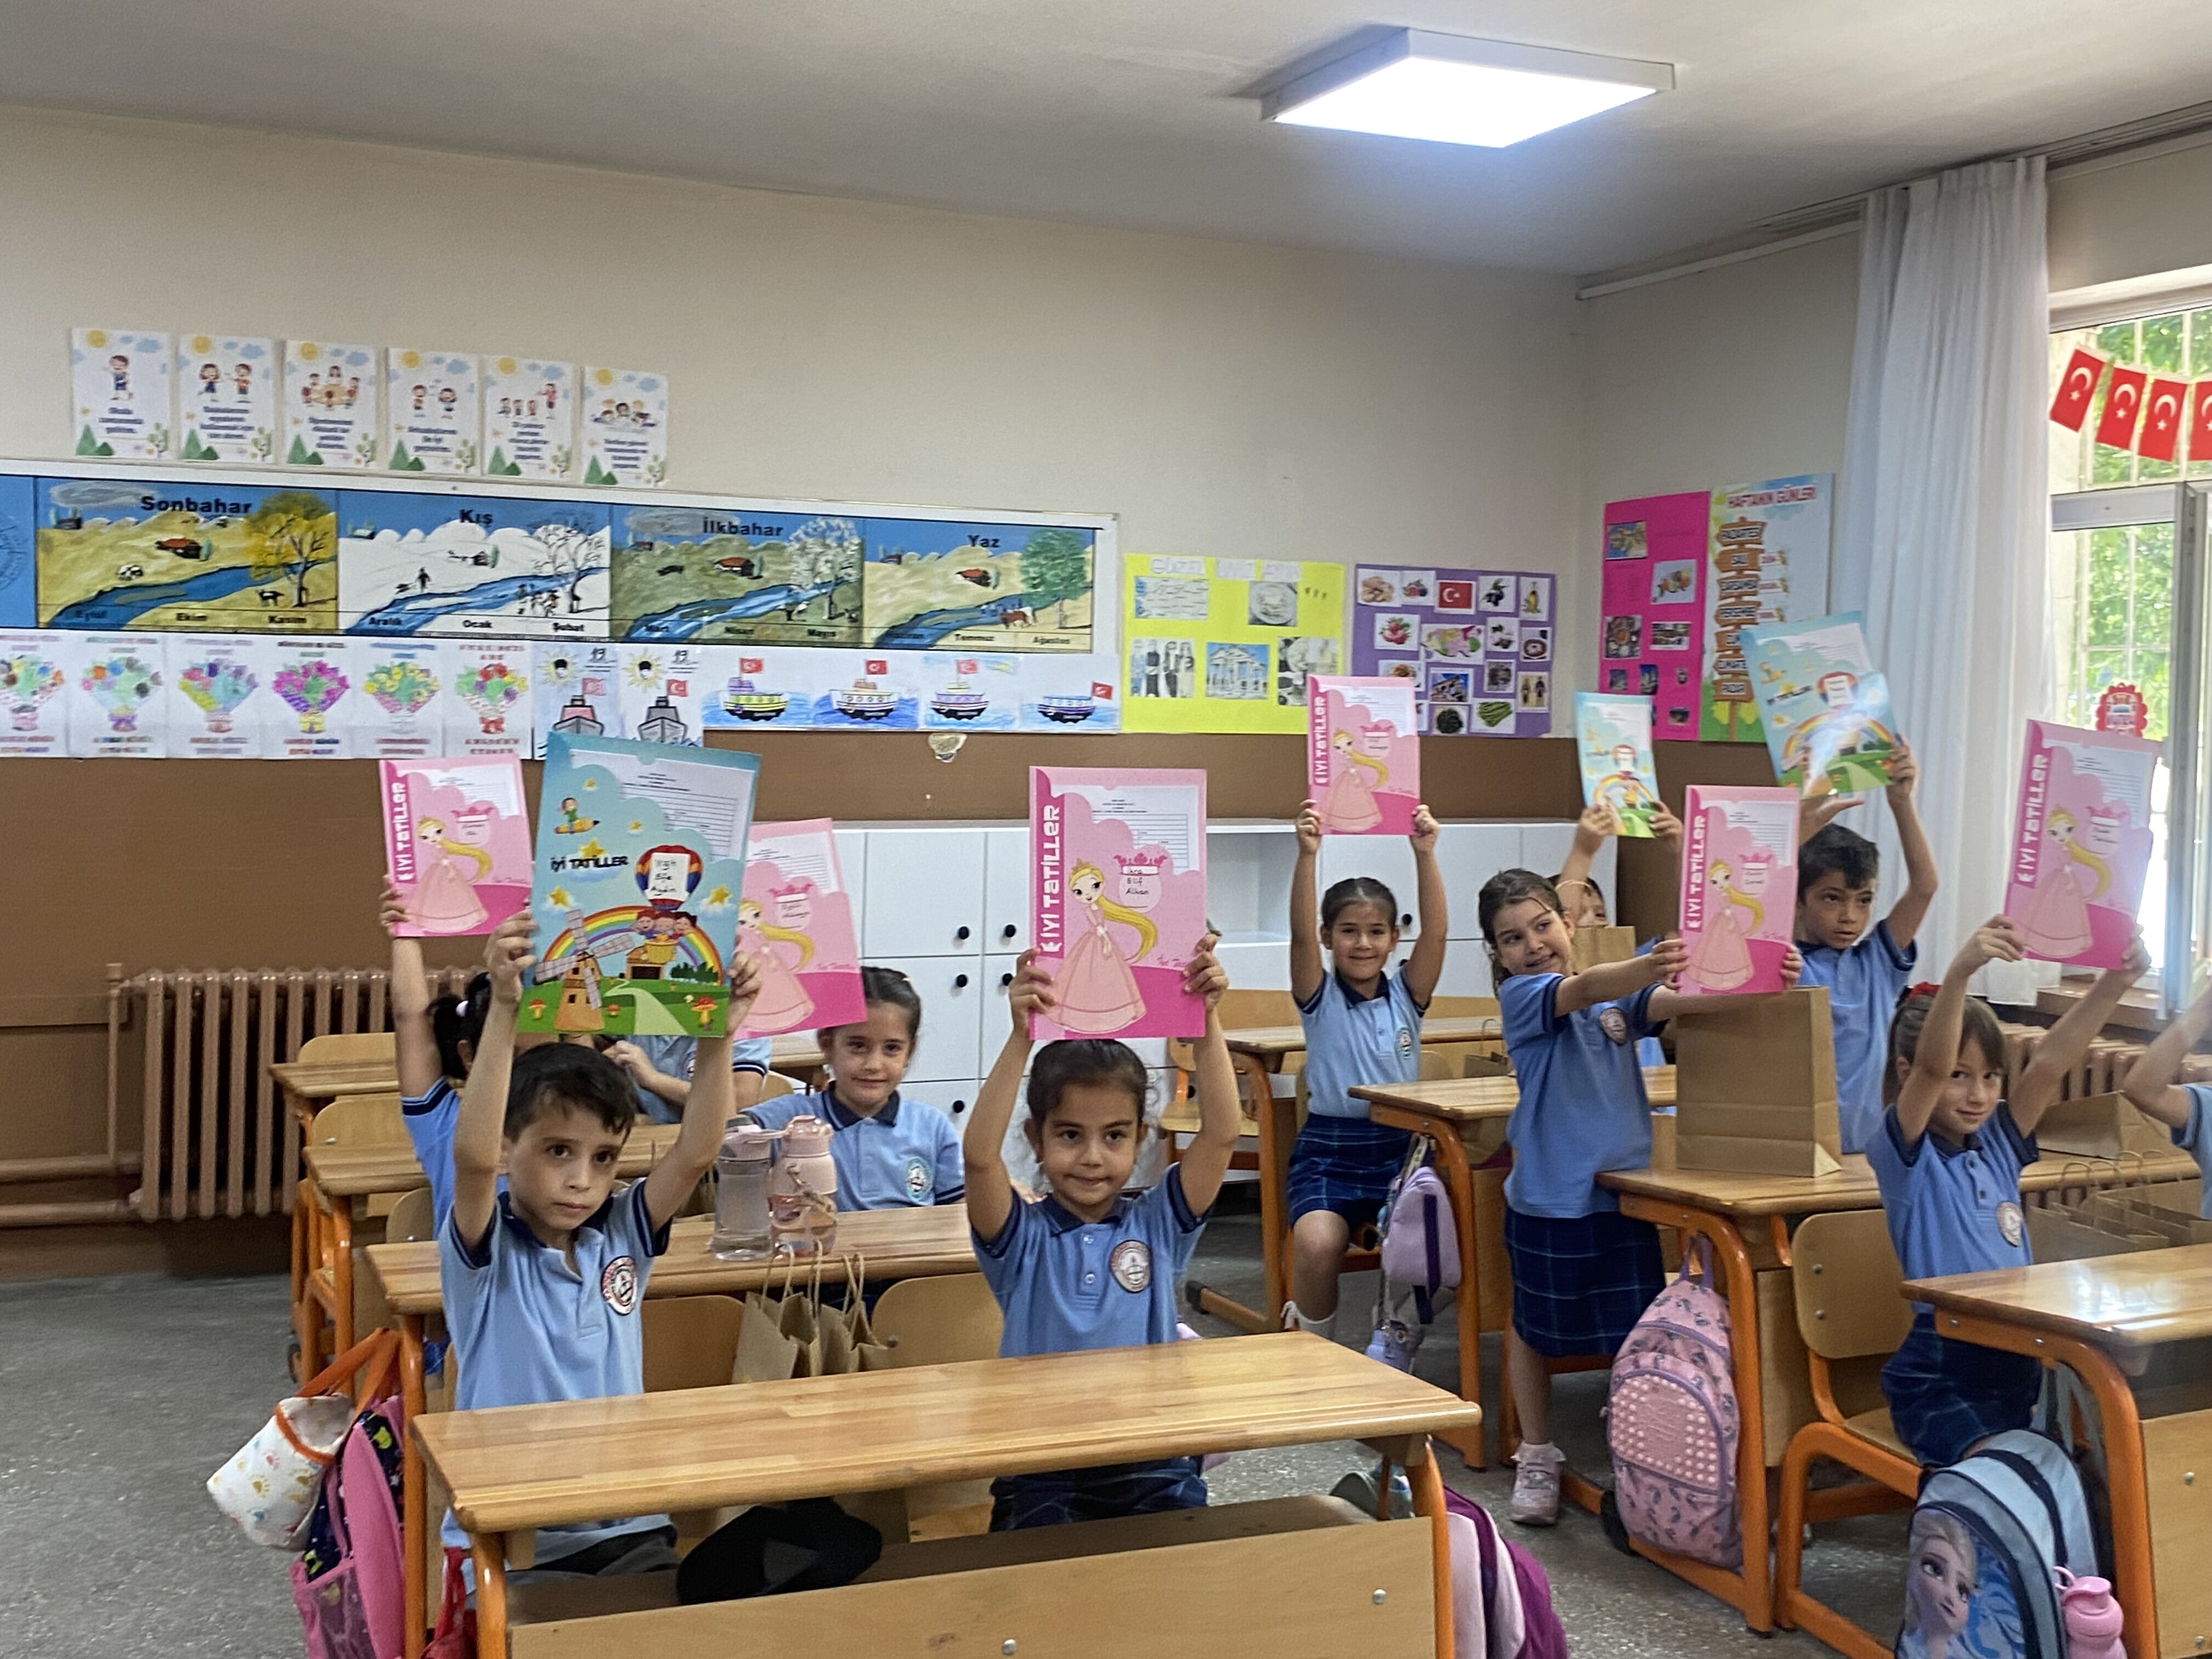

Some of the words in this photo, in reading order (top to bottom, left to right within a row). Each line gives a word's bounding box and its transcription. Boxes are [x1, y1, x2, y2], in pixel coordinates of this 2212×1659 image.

[140, 496, 252, 514] Sonbahar
[703, 517, 784, 536] İlkbahar
[967, 535, 1001, 548] Yaz
[176, 613, 207, 622] Ekim
[462, 619, 493, 629] Ocak
[955, 634, 995, 642] Temmuz
